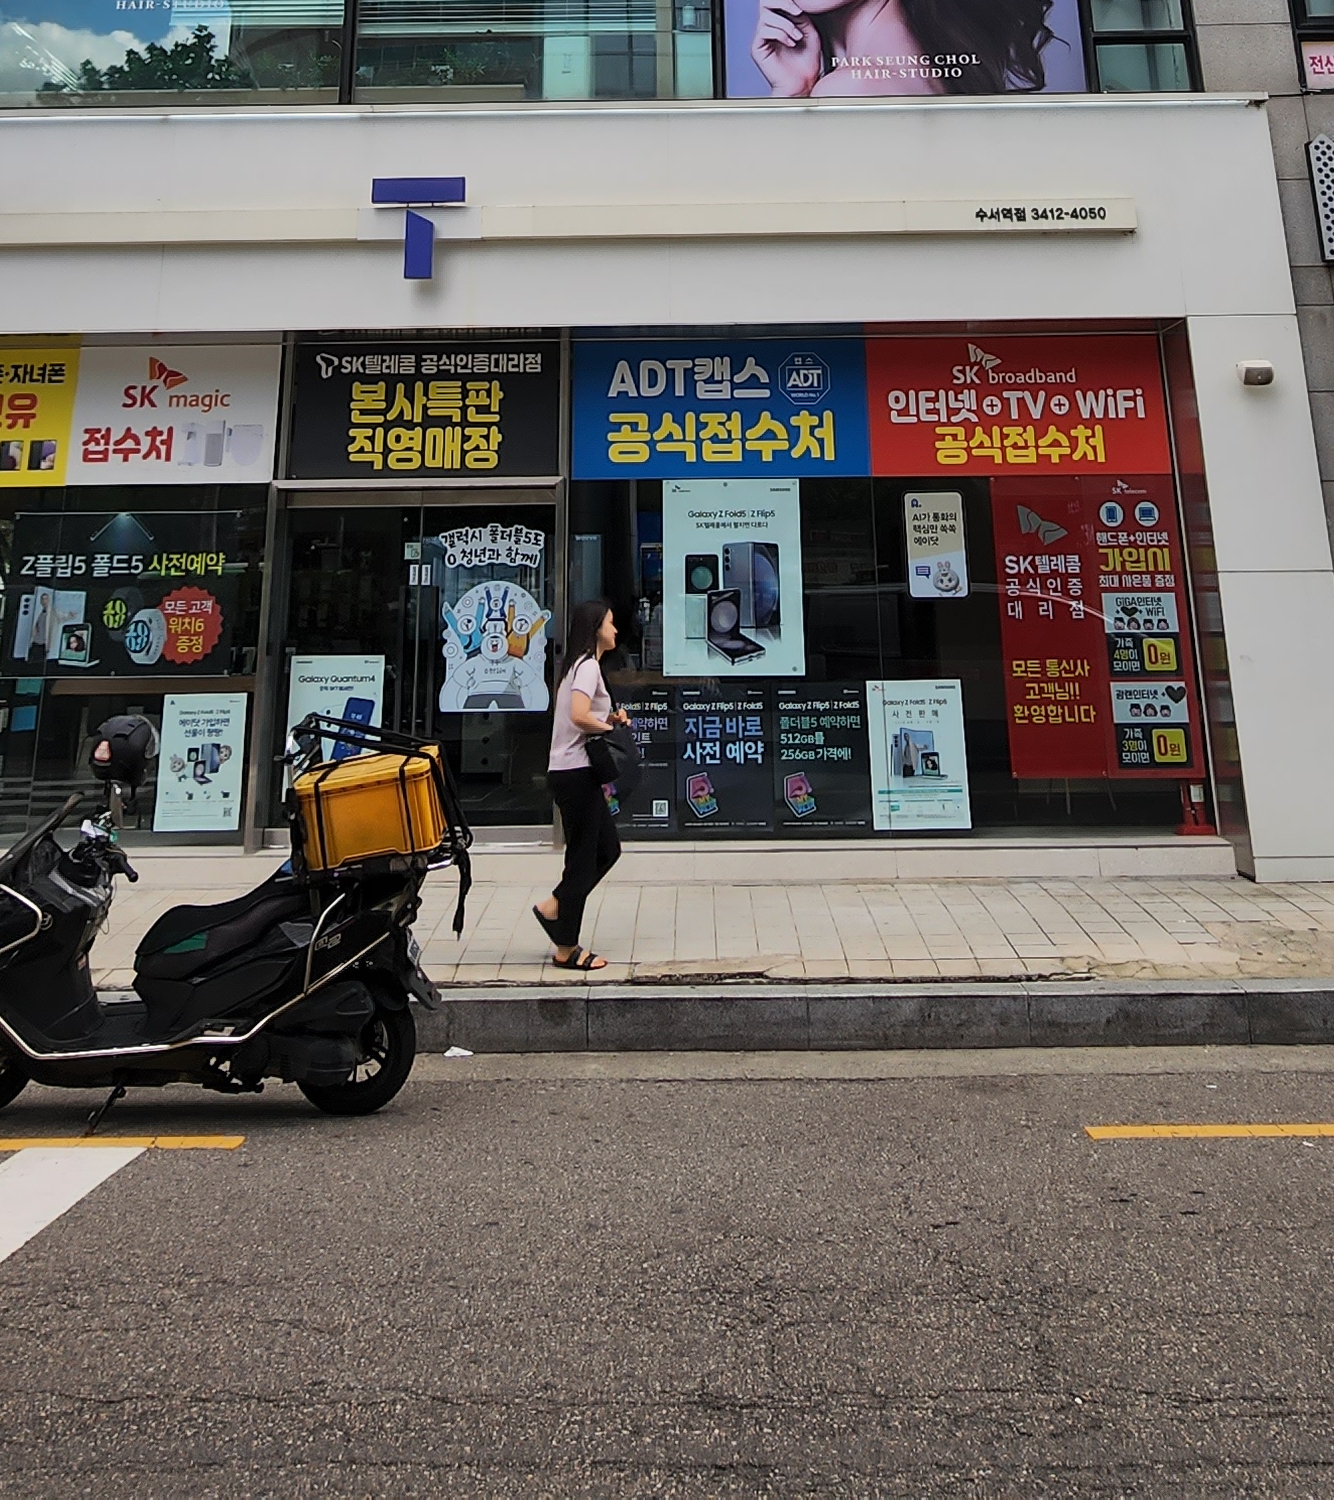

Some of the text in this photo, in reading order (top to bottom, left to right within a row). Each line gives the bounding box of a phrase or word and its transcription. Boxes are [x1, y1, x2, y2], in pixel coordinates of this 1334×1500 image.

[831, 54, 981, 68] PARK SEUNG CHOL
[851, 67, 963, 80] HAIR-STUDIO
[975, 206, 1107, 222] 수서역점 3412-4050
[340, 353, 542, 375] SK텔레콤 공식인증대리점
[607, 357, 771, 399] ADT캡스
[787, 369, 822, 387] ADT
[952, 365, 1077, 384] SK broadband
[122, 385, 231, 413] SK magic
[349, 379, 505, 424] 본사특판
[81, 426, 174, 464] 접수처
[607, 409, 836, 463] 공식접수처
[934, 424, 1107, 465] 공식접수처
[347, 425, 503, 470] 직영매장
[687, 509, 776, 519] Galaxy Fold5 Flip5
[441, 528, 483, 548] 갤럭시
[20, 552, 226, 577] Z플립5 폴드5 사전예약
[460, 545, 539, 565] 청년과 함께
[1004, 554, 1081, 575] SK텔레콤
[1098, 547, 1171, 572] 가입시
[164, 600, 213, 615] 모든 고객
[169, 617, 205, 634] 워치6
[176, 636, 204, 653] 증정
[1115, 637, 1134, 648] 가족
[1012, 659, 1091, 678] 모든 통신사
[1113, 660, 1141, 672] 모이면
[298, 674, 376, 684] Galaxy Quantum4
[1025, 682, 1080, 701] 고객님!!
[682, 702, 710, 712] Galaxy
[778, 700, 807, 712] Galaxy
[1013, 704, 1097, 724] 환영합니다
[684, 715, 764, 739] 지금 바로
[819, 715, 861, 729] 예약하면
[1123, 728, 1143, 739] 가족
[682, 740, 765, 765] 사전 예약
[1122, 752, 1150, 764] 모이면
